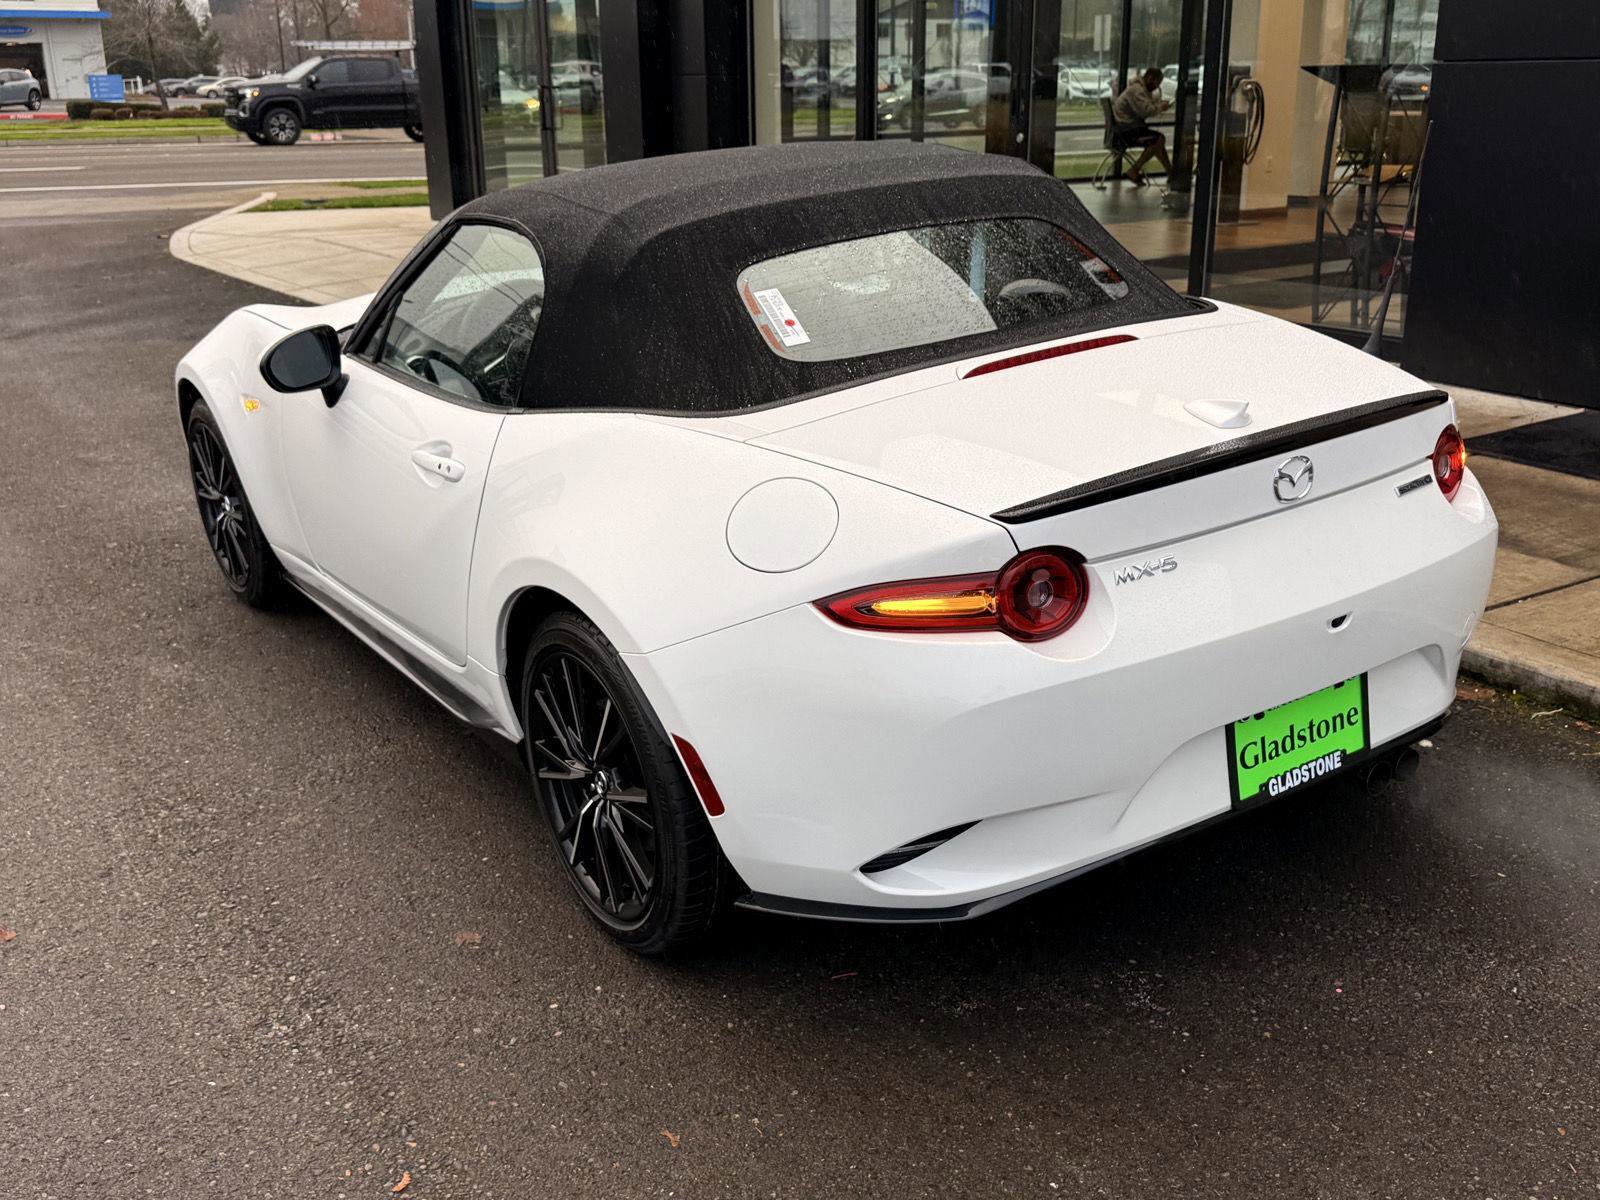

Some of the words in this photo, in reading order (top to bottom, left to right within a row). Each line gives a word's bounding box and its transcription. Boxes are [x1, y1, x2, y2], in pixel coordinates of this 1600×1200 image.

[1113, 555, 1178, 586] MX-5
[1239, 706, 1359, 770] Gladstone
[1268, 750, 1342, 797] GLADSTONE
